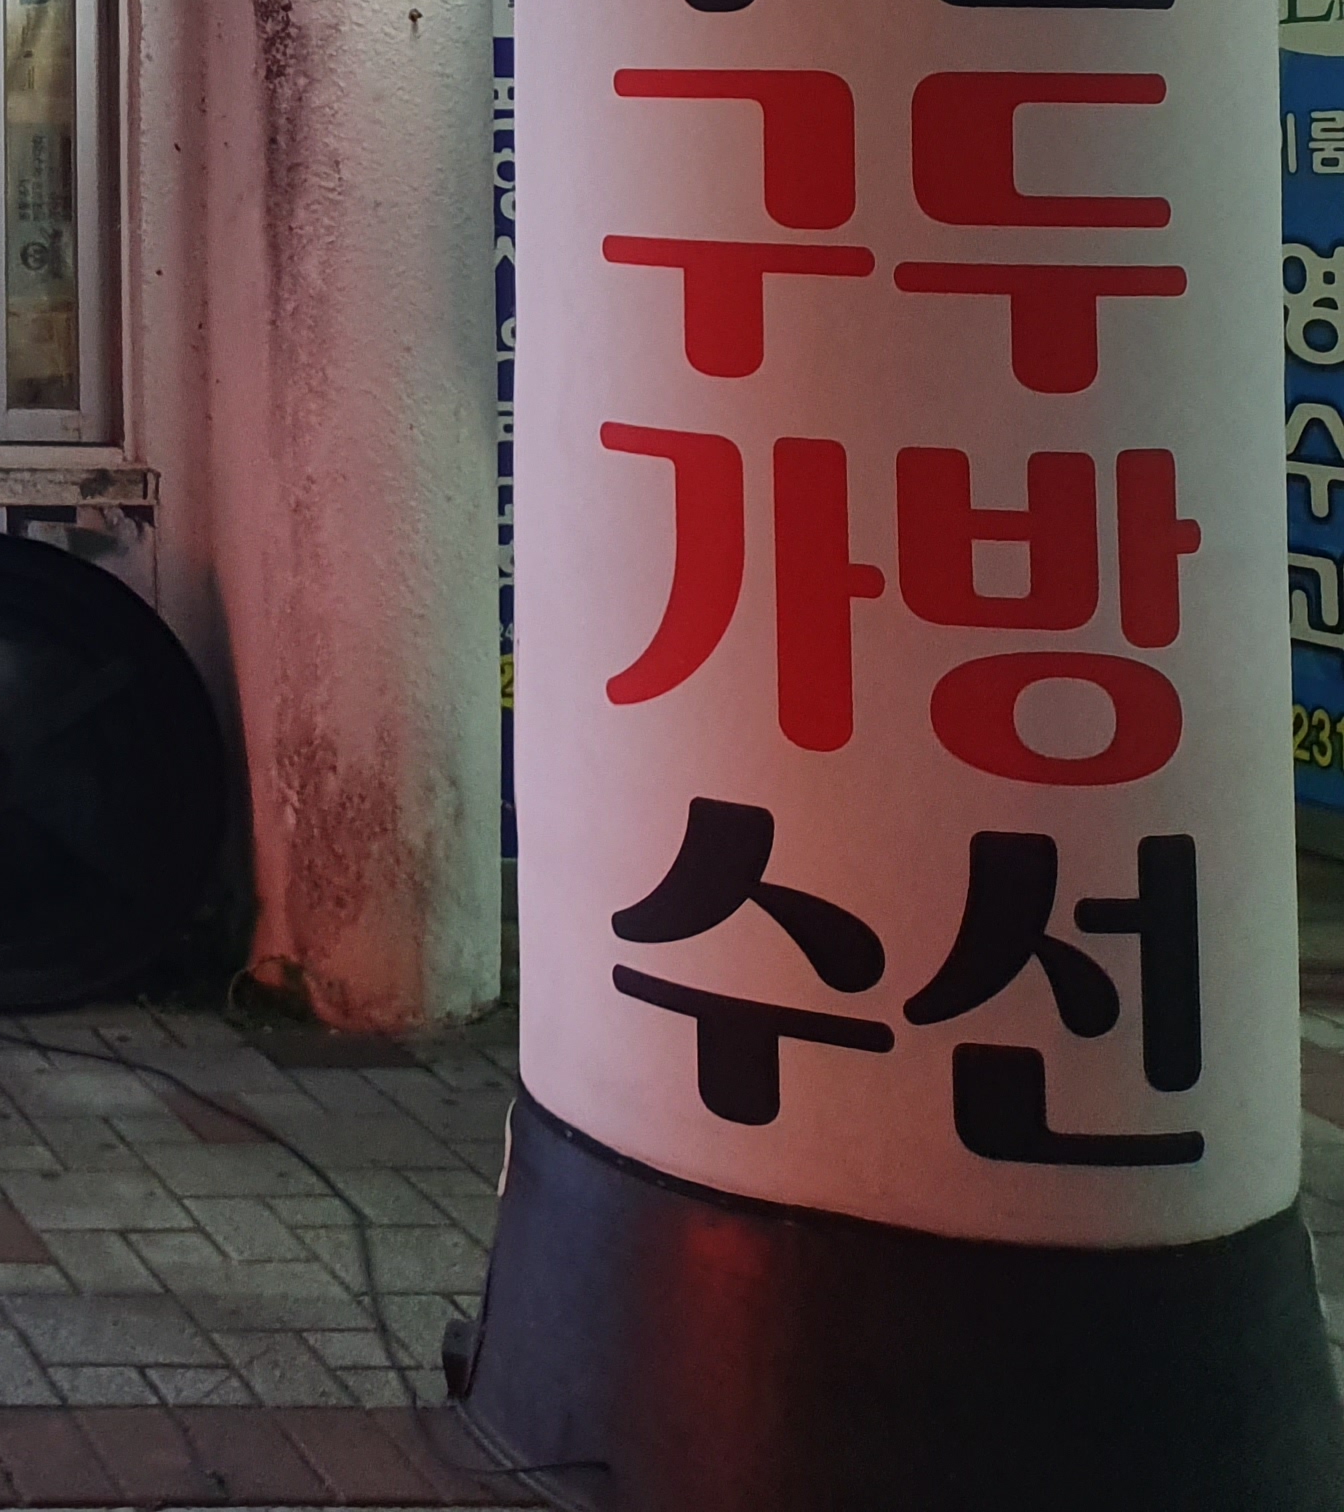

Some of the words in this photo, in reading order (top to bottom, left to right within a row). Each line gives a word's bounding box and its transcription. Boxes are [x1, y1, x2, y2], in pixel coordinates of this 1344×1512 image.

[602, 68, 1188, 394] 구두
[600, 421, 1202, 787] 가방
[610, 796, 1205, 1167] 수선
